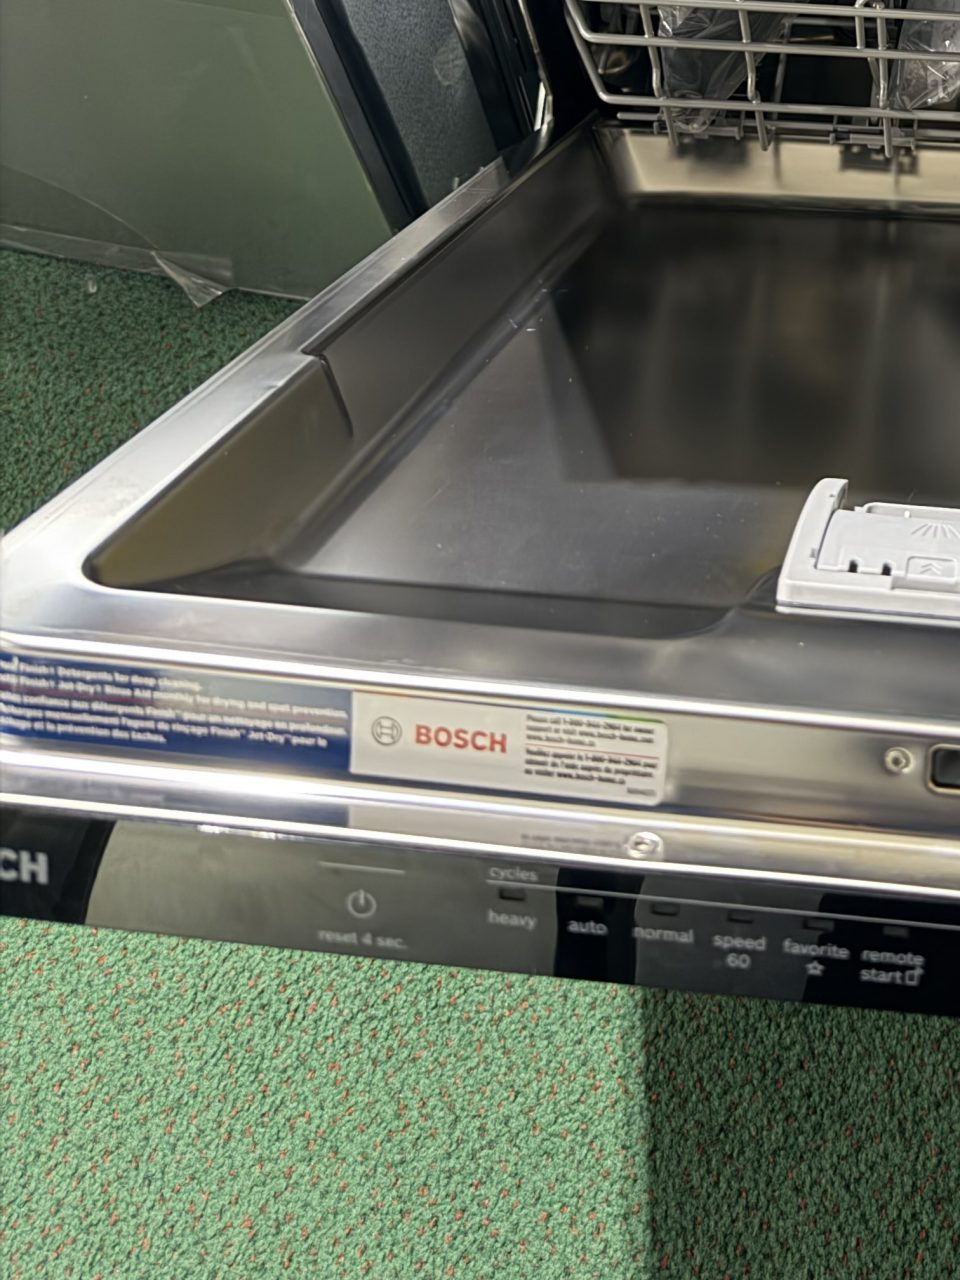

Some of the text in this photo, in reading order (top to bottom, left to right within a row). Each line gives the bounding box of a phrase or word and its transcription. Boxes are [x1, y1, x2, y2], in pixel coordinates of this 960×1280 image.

[415, 723, 507, 754] BOSCH
[488, 865, 539, 883] cycles
[317, 928, 409, 951] reset 4 sec.
[486, 909, 926, 967] heavy auto normal speed favorite remote
[726, 953, 751, 969] 60
[859, 967, 901, 985] start
